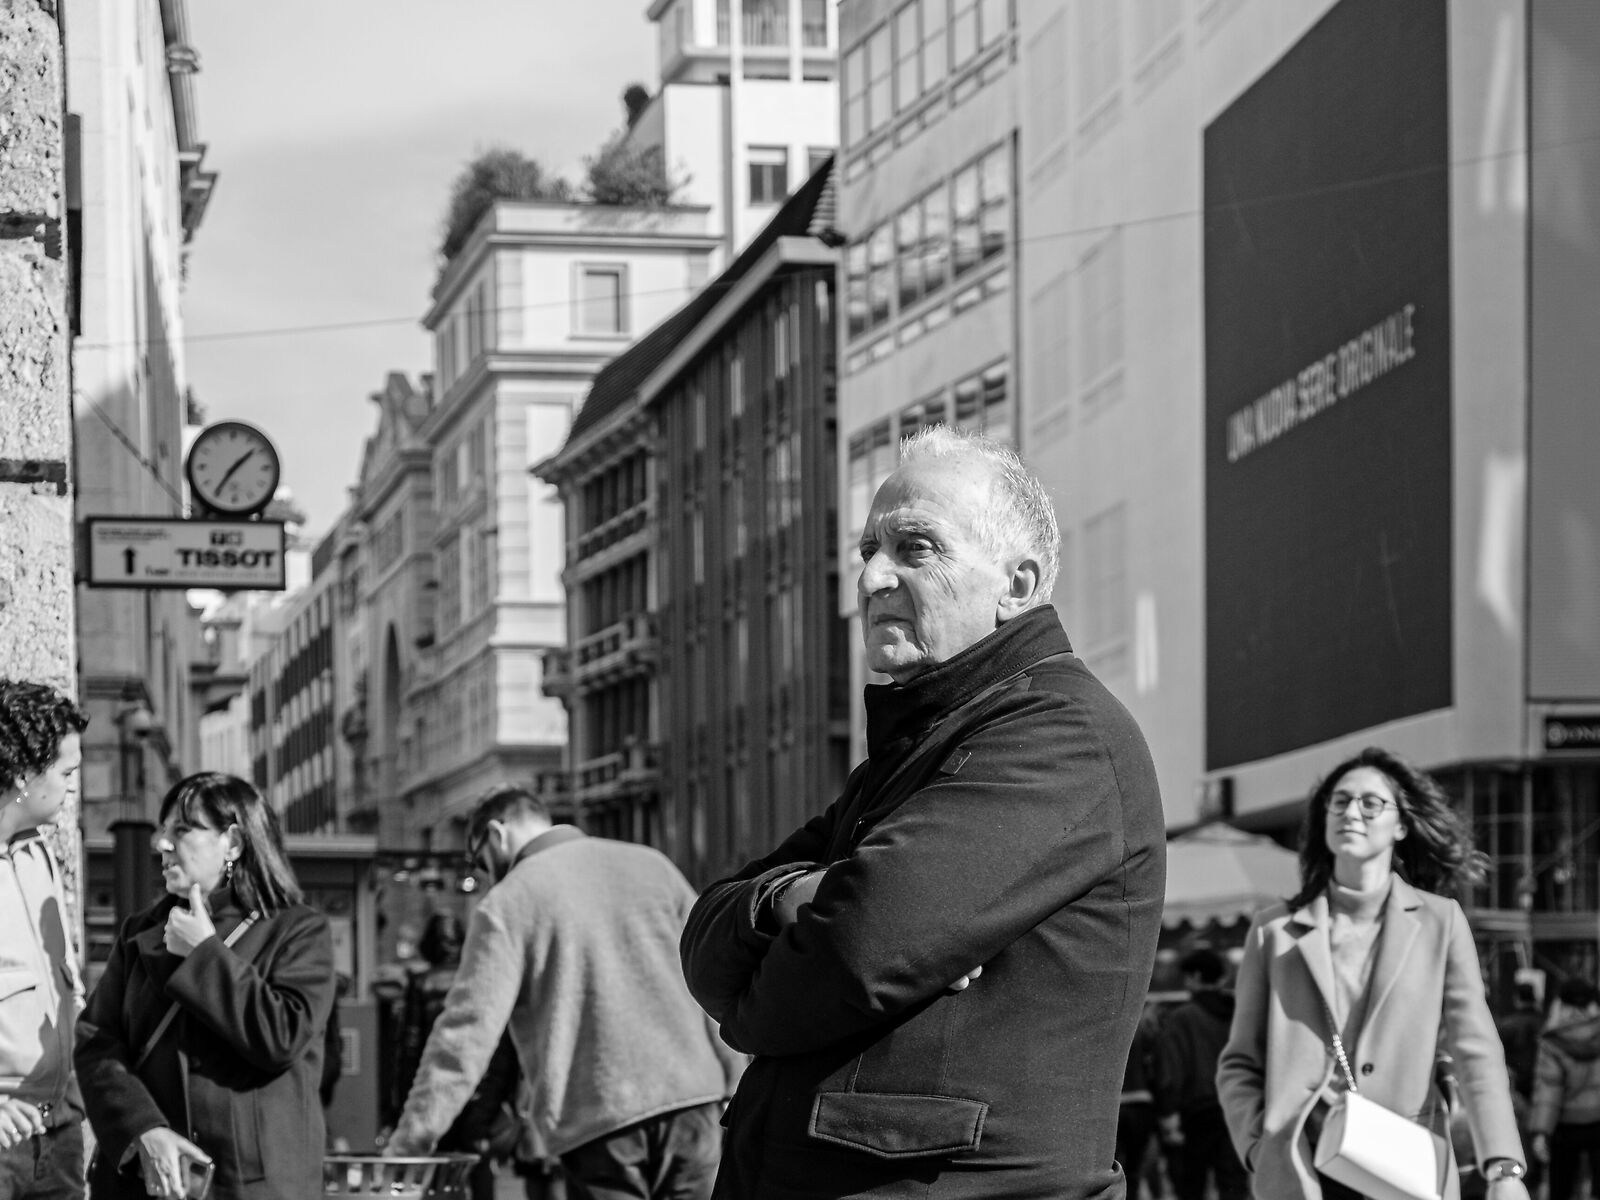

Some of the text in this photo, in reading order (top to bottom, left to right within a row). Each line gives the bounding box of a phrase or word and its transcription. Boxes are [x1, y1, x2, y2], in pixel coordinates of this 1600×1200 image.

[1298, 353, 1337, 421] SERIE
[1337, 302, 1416, 398] ORIGINALE
[176, 547, 275, 568] TISSOT
